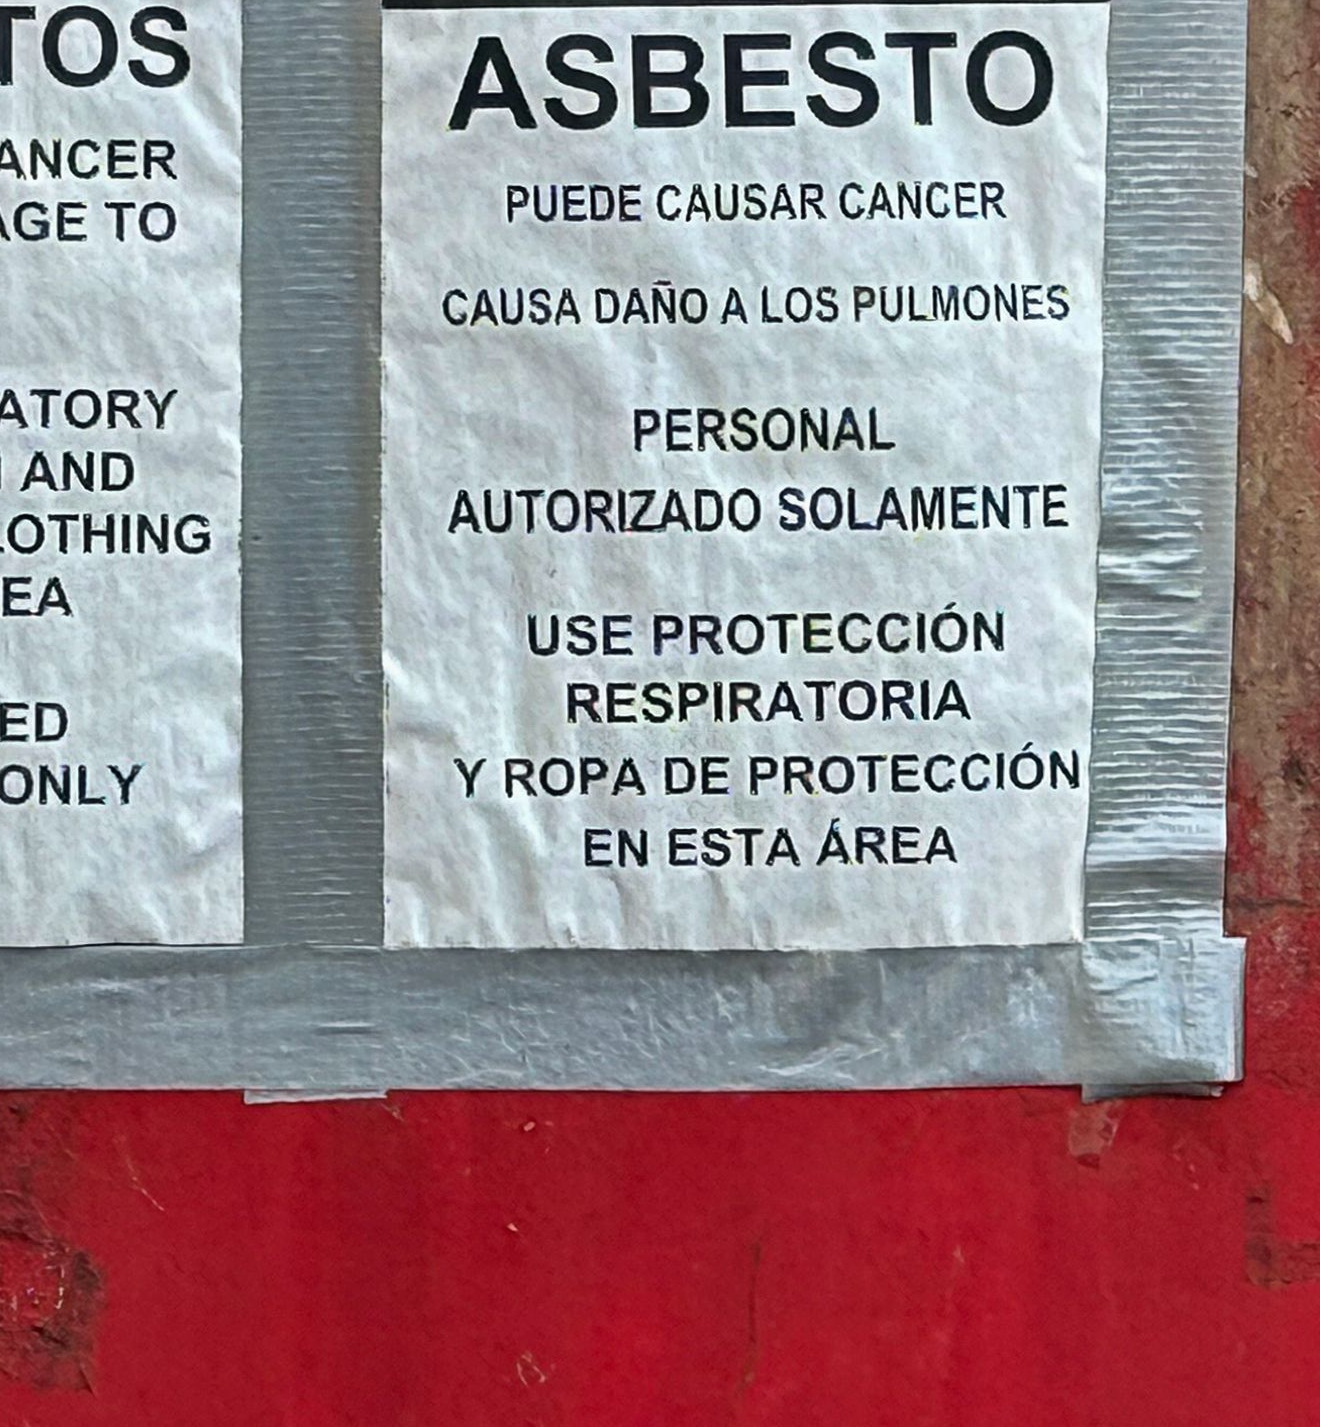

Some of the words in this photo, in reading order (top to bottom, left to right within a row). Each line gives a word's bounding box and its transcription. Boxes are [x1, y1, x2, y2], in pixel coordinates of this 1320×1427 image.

[449, 31, 1053, 130] ASBESTO
[104, 202, 176, 242] TO
[507, 185, 641, 222] PUEDE
[657, 183, 826, 222] CAUSAR
[839, 182, 1006, 220] CANCER
[442, 288, 580, 326] CAUSA
[595, 280, 707, 324] DAÑO
[721, 287, 747, 324] A
[762, 286, 838, 323] LOS
[854, 283, 1069, 322] PULMONES
[634, 407, 895, 452] PERSONAL
[20, 451, 134, 492] AND
[448, 488, 760, 534] AUTORIZADO
[779, 484, 1068, 531] SOLAMENTE
[528, 615, 633, 656] USE
[654, 602, 1004, 656] PROTECCIÓN
[567, 679, 971, 723] RESPIRATORIA
[454, 759, 486, 798] Y
[505, 757, 646, 798] ROPA
[665, 757, 729, 795] DE
[750, 742, 1079, 795] PROTECCIÓN
[585, 829, 648, 867] EN
[669, 828, 800, 866] ESTA
[816, 818, 957, 865] ÁREA
